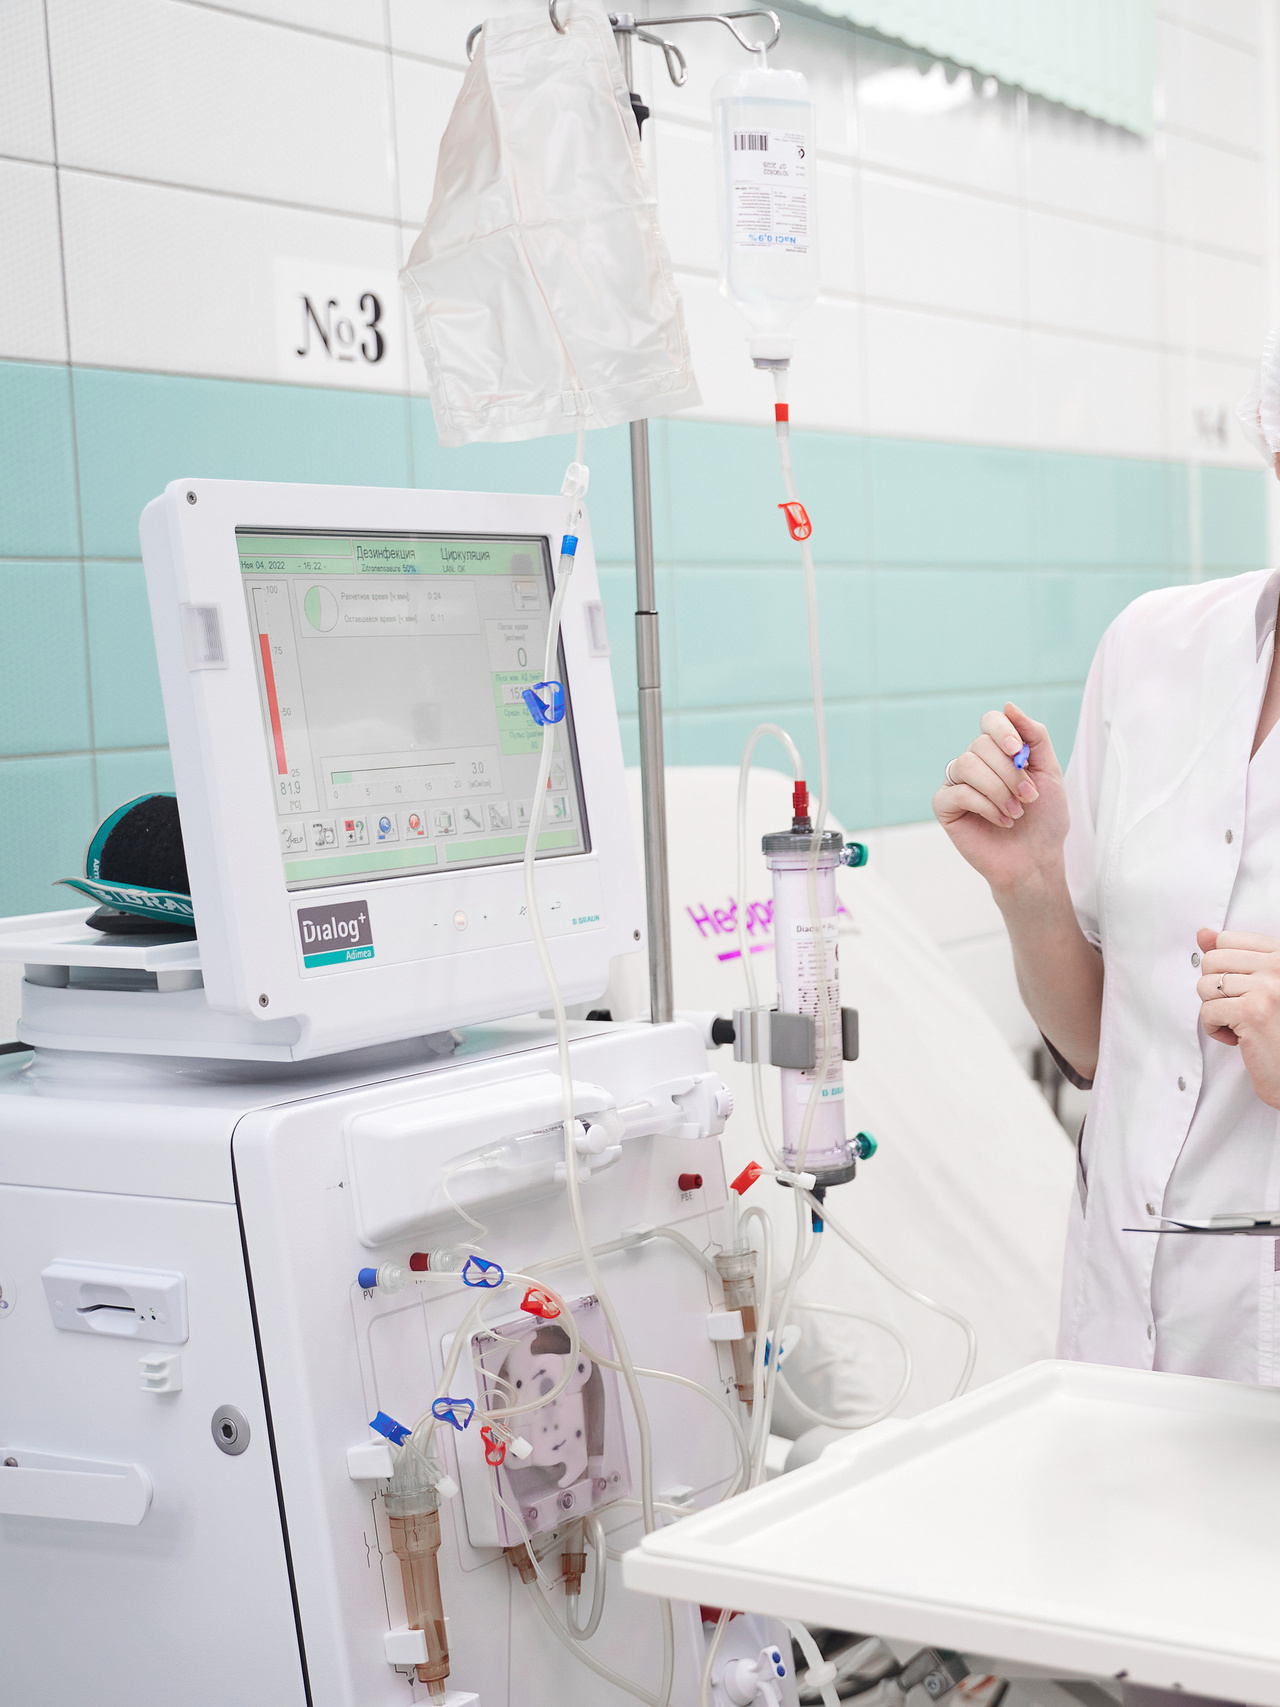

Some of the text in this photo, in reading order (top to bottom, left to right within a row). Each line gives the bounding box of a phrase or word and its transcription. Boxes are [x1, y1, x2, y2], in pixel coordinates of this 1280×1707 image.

[775, 235, 796, 244] NaCl
[357, 546, 491, 562] Дезинфекция Циркуляция
[268, 561, 285, 569] 2022
[291, 836, 304, 844] HELP
[346, 950, 372, 960] Adimea
[681, 1191, 693, 1202] PBE
[363, 1289, 374, 1300] PV
